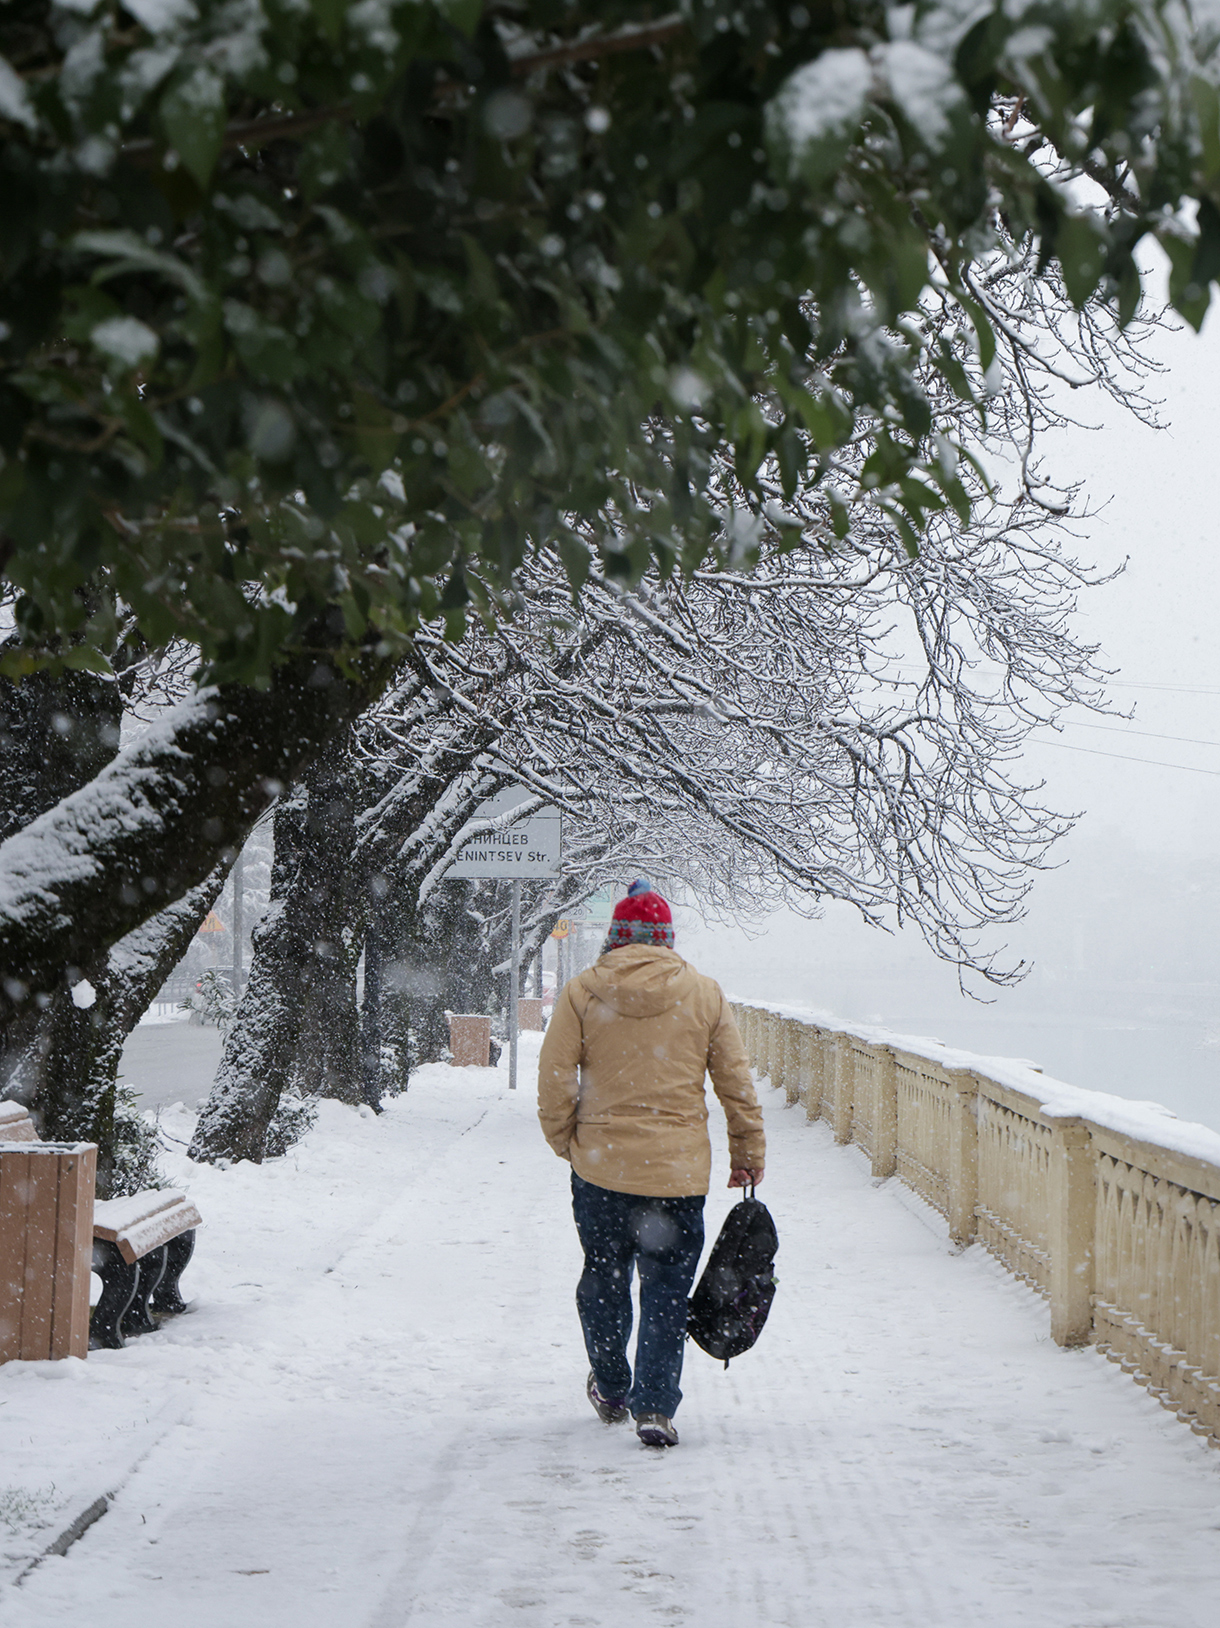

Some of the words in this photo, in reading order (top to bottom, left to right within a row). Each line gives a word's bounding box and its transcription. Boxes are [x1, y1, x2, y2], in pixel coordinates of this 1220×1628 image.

[469, 834, 529, 846] НИНЦЕВ
[456, 850, 523, 862] ENINTSEV
[527, 851, 551, 862] Str.
